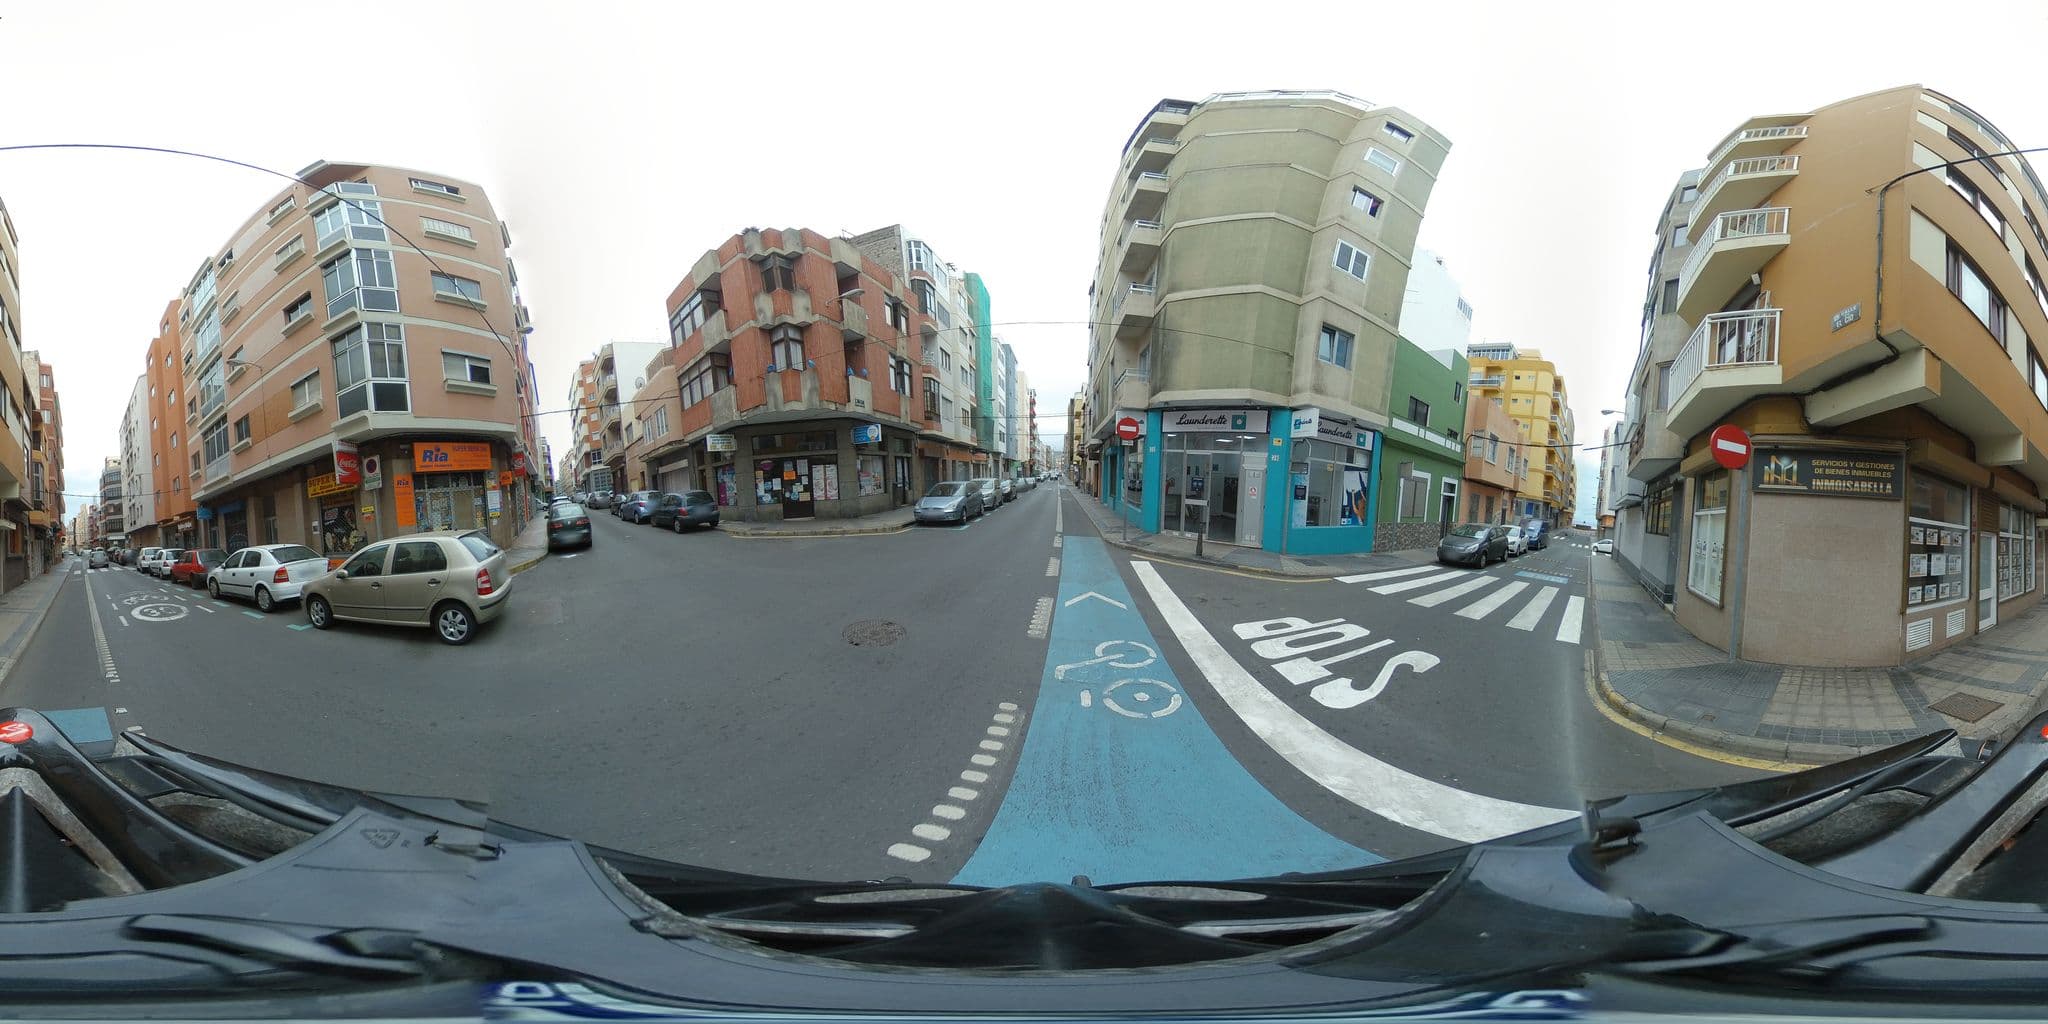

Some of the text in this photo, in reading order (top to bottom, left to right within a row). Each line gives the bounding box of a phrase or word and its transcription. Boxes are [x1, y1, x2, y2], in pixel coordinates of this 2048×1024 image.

[1176, 412, 1228, 425] Launderette
[422, 447, 448, 463] Ria
[1811, 459, 1848, 468] SERVICIOS
[1855, 461, 1896, 470] GESTIONES
[1825, 469, 1851, 477] BIENES
[1851, 470, 1892, 478] INMUEBLES
[1811, 479, 1893, 494] INMOISABELLA
[1232, 617, 1441, 709] STOP
